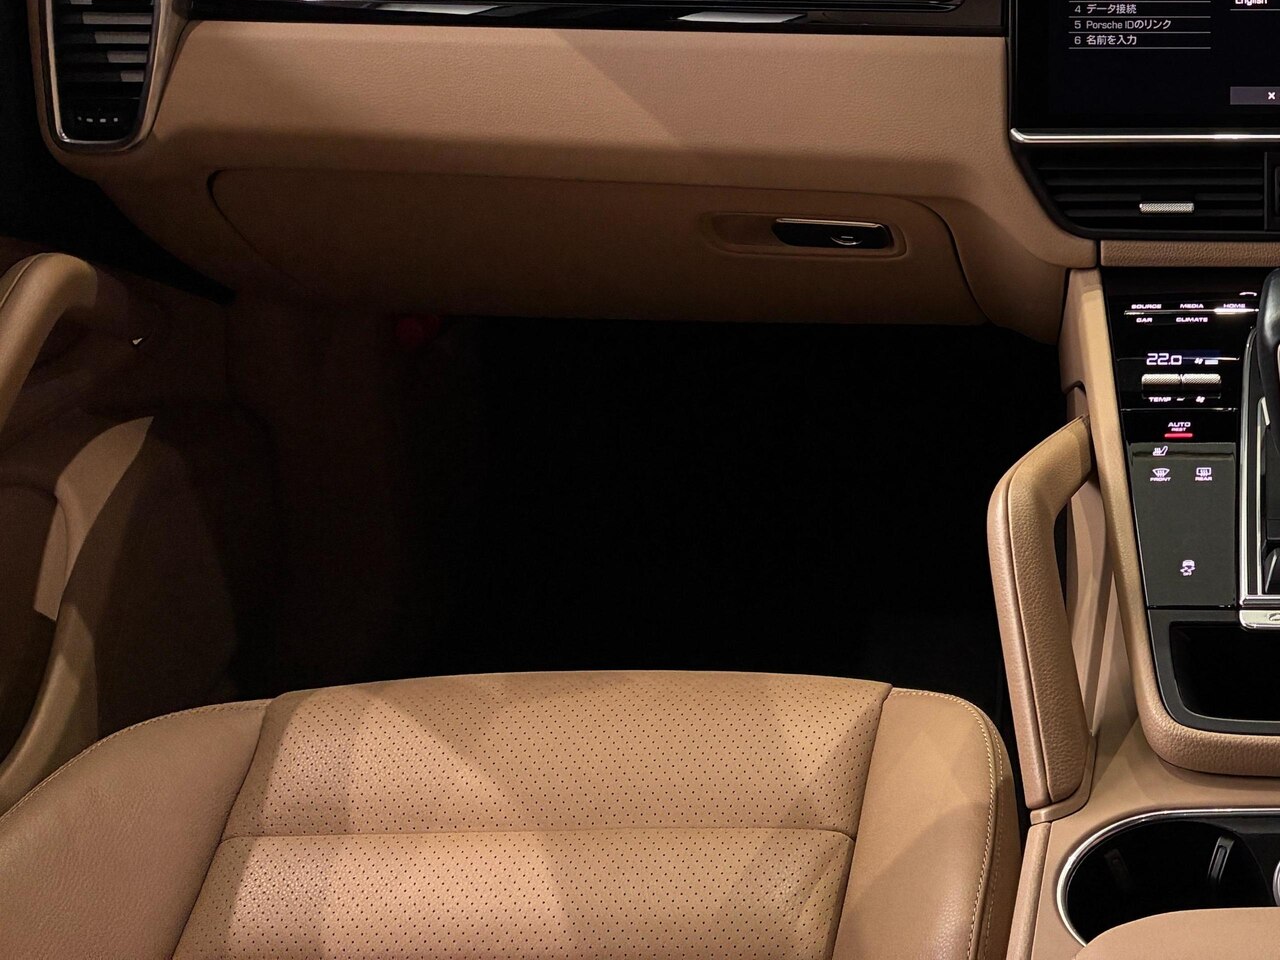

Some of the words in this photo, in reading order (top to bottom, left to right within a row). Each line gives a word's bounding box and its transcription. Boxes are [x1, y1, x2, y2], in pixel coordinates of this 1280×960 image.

[1074, 5, 1081, 13] 4
[1086, 4, 1137, 14] データ接続
[1074, 20, 1081, 29] 5
[1086, 20, 1122, 29] Porsche
[1125, 20, 1172, 30] IDのリンク
[1074, 36, 1081, 44] 6
[1086, 35, 1137, 45] 名前を入力
[1146, 353, 1182, 365] 22.0
